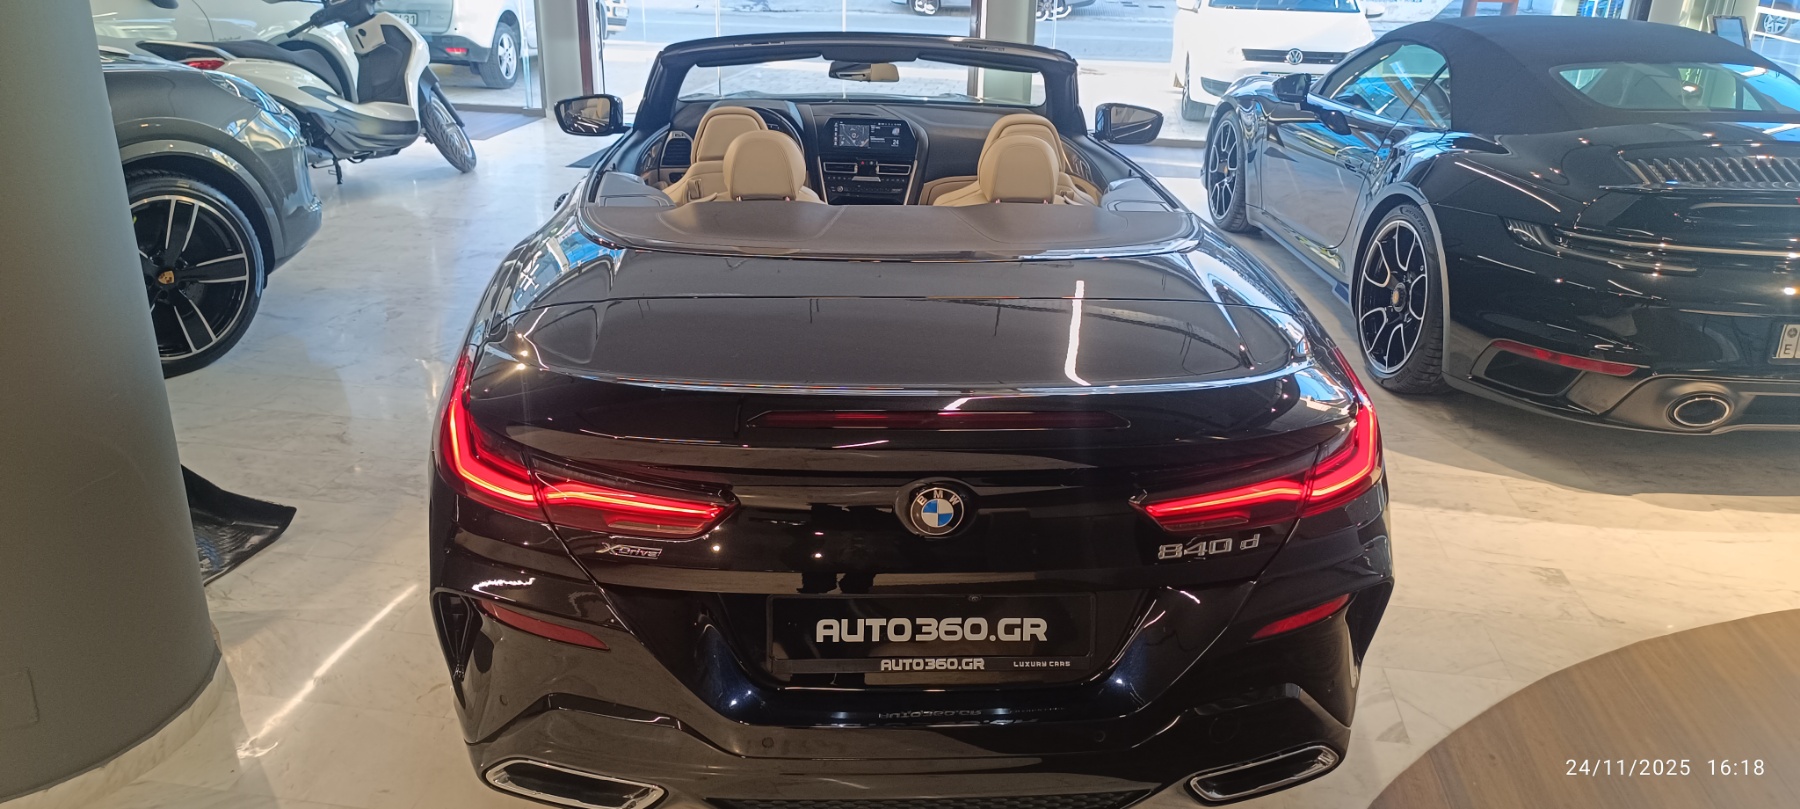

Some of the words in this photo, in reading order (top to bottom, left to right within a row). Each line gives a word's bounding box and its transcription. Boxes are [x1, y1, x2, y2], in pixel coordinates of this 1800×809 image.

[1783, 344, 1792, 354] E
[916, 489, 960, 506] BMW
[1158, 538, 1233, 560] 840
[1240, 533, 1260, 550] d
[816, 617, 1048, 643] AUTO360.GR
[880, 657, 985, 671] AUTO360.GR
[1013, 660, 1047, 668] LUXURY
